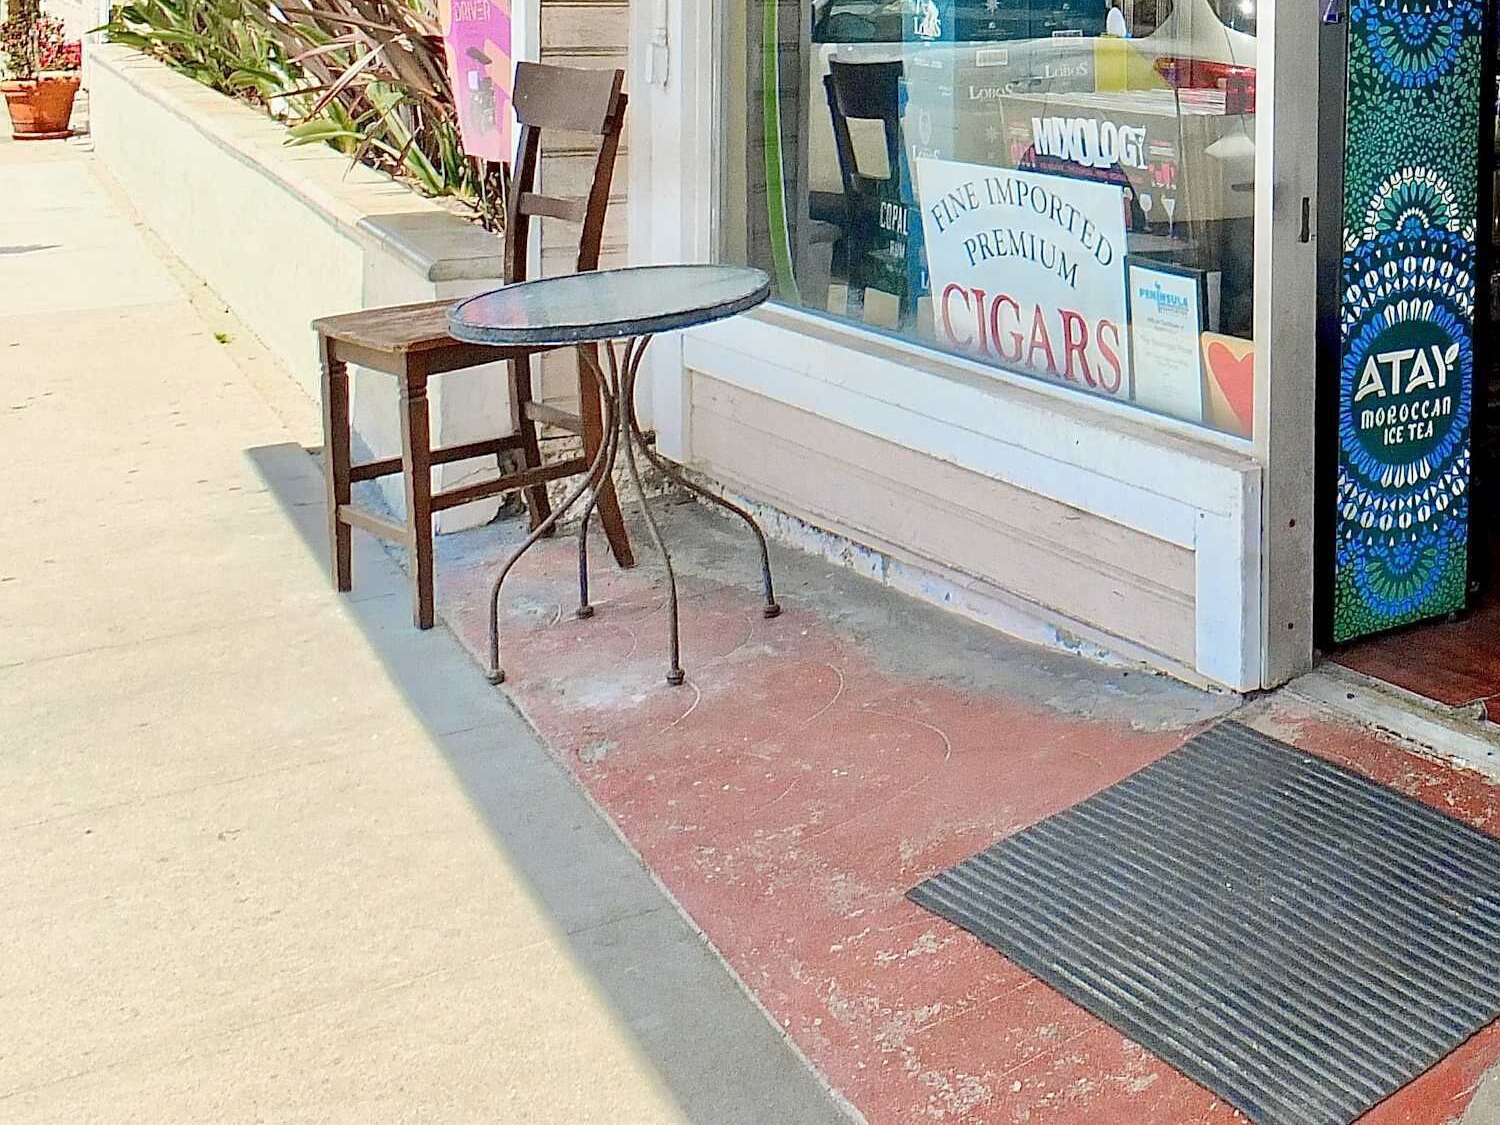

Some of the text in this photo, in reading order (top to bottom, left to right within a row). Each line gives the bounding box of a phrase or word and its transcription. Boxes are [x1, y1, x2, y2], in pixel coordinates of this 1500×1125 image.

[931, 177, 1112, 266] FINE IMPORTED
[963, 229, 1078, 288] PREMIUM
[942, 283, 1121, 393] CIGARS
[1354, 342, 1459, 402] ATAY
[1361, 396, 1451, 430] MOROCCAN
[1384, 420, 1433, 445] ICE TEA
